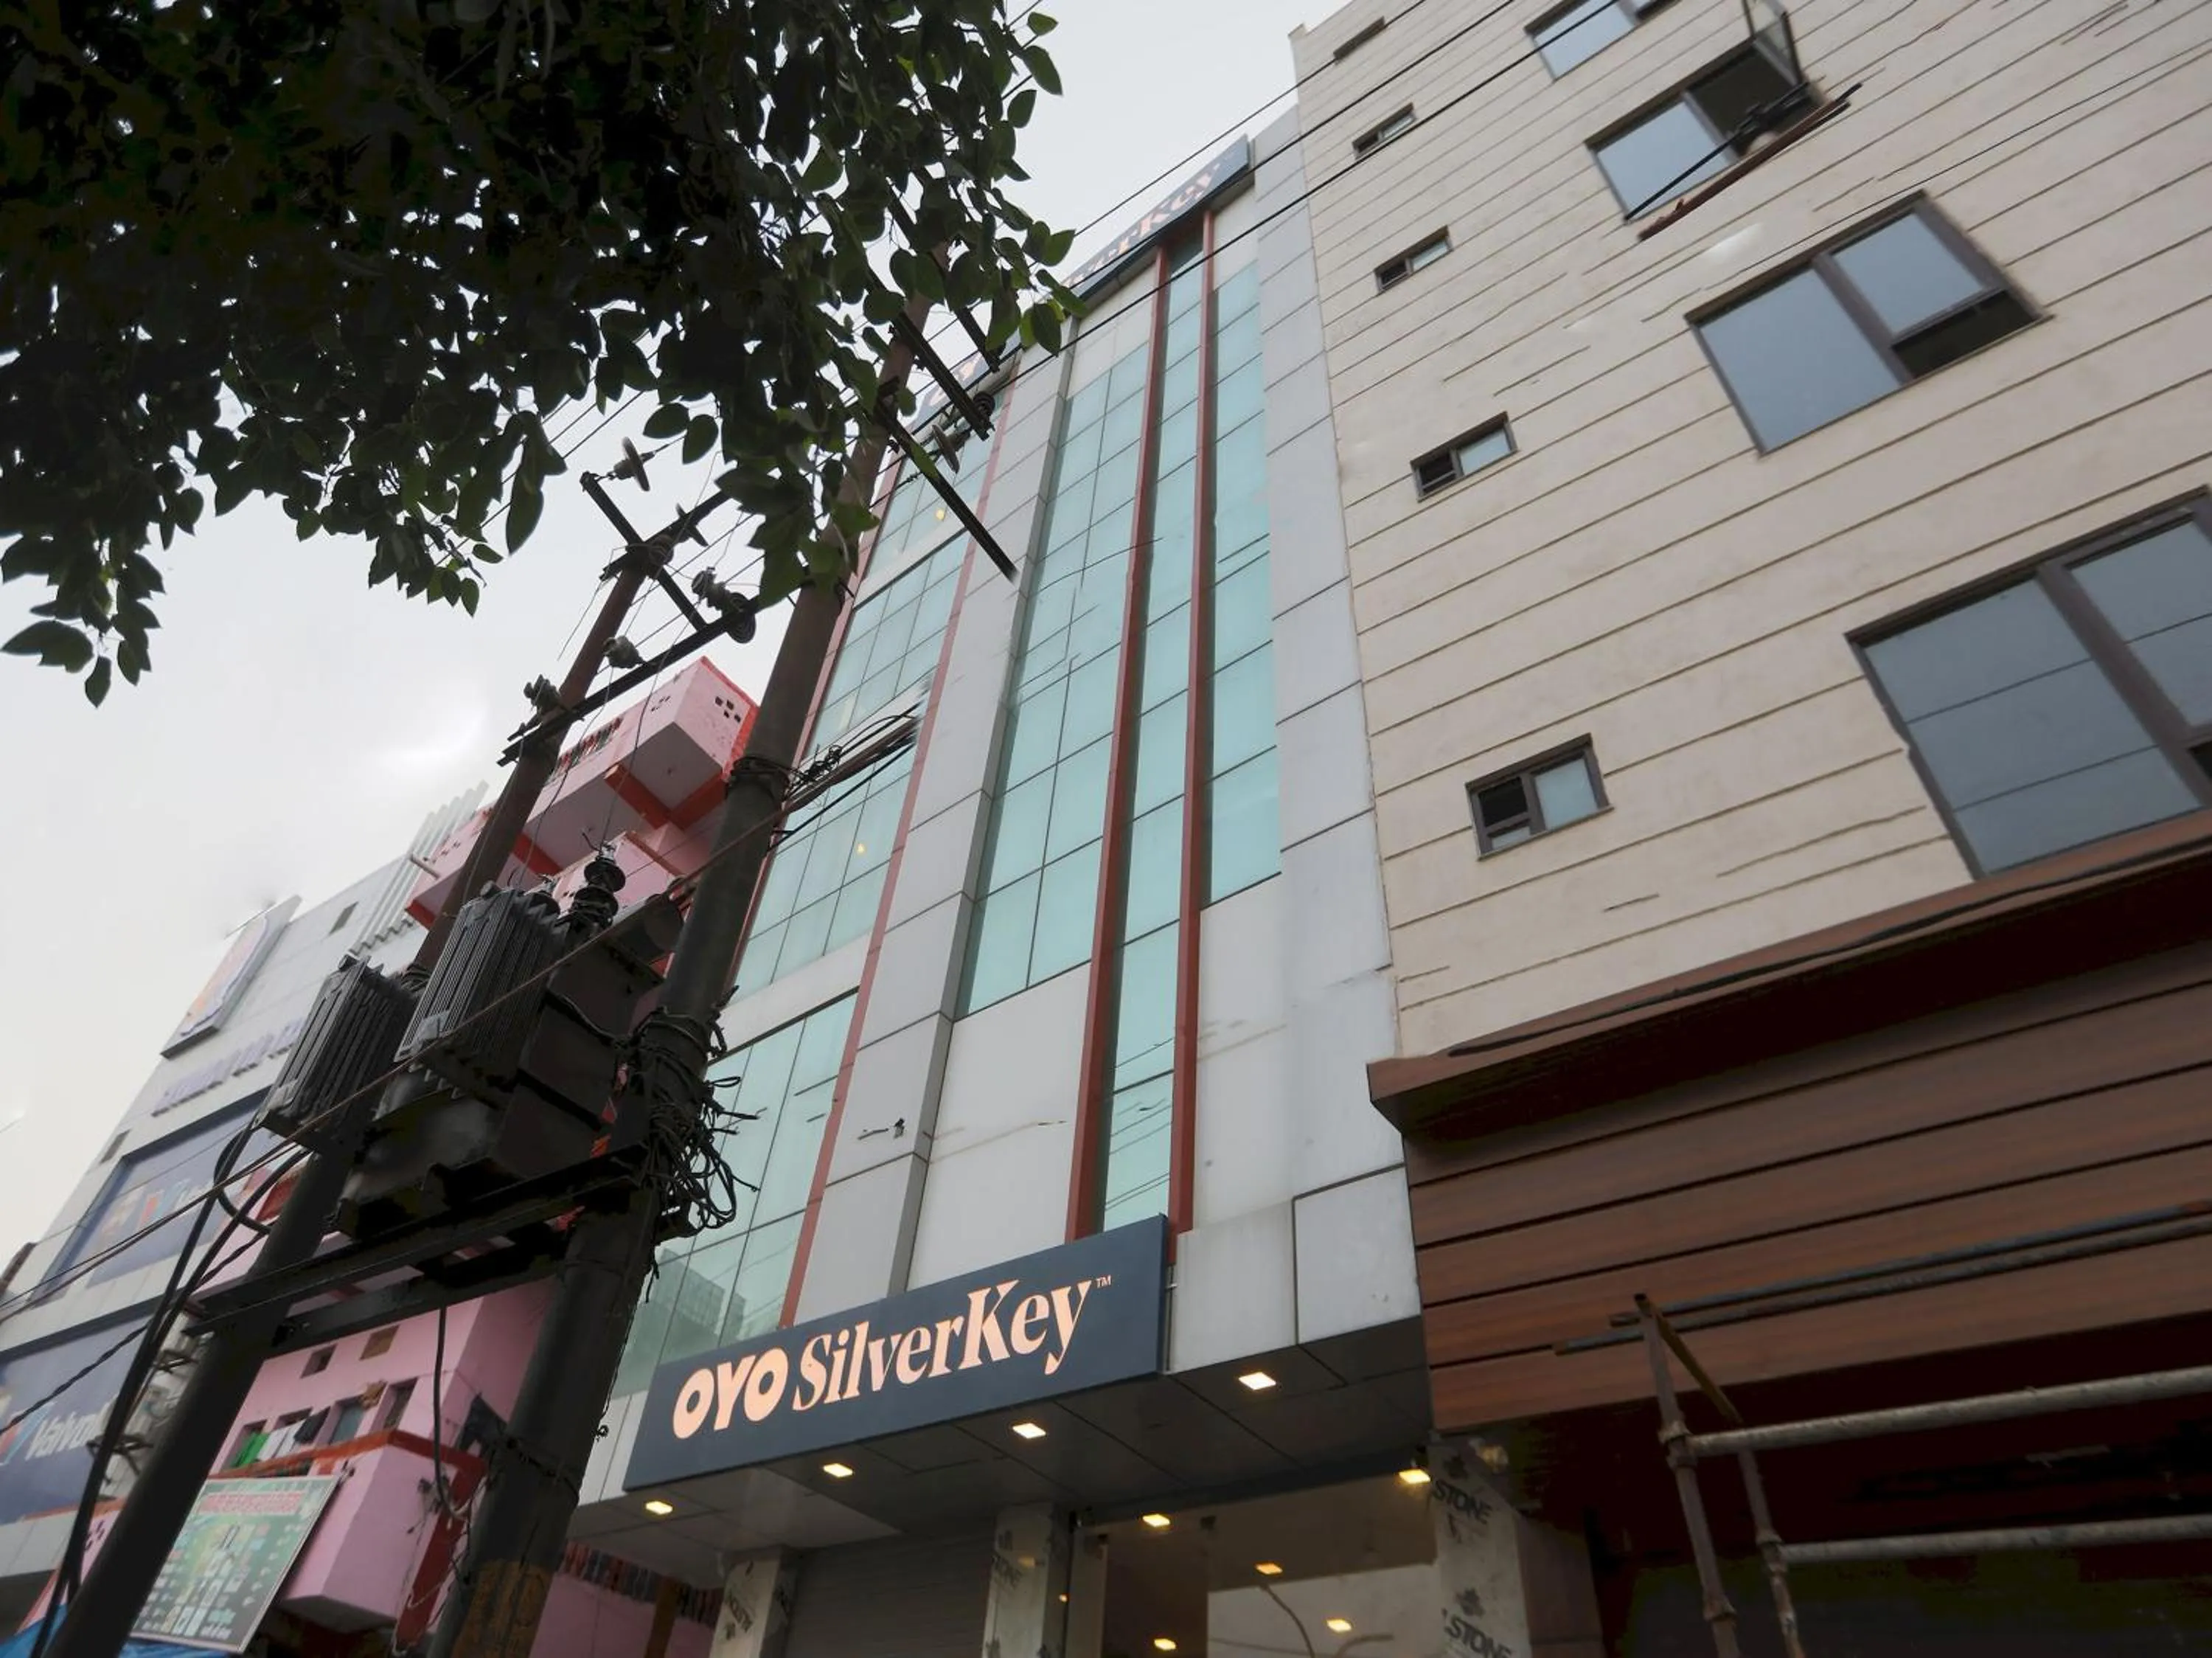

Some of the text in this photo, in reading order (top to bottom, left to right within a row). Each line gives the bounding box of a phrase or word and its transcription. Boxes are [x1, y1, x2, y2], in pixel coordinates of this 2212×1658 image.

[672, 1347, 789, 1440] OYO
[793, 1279, 1093, 1411] SilverKey
[1432, 1480, 1493, 1525] STONE
